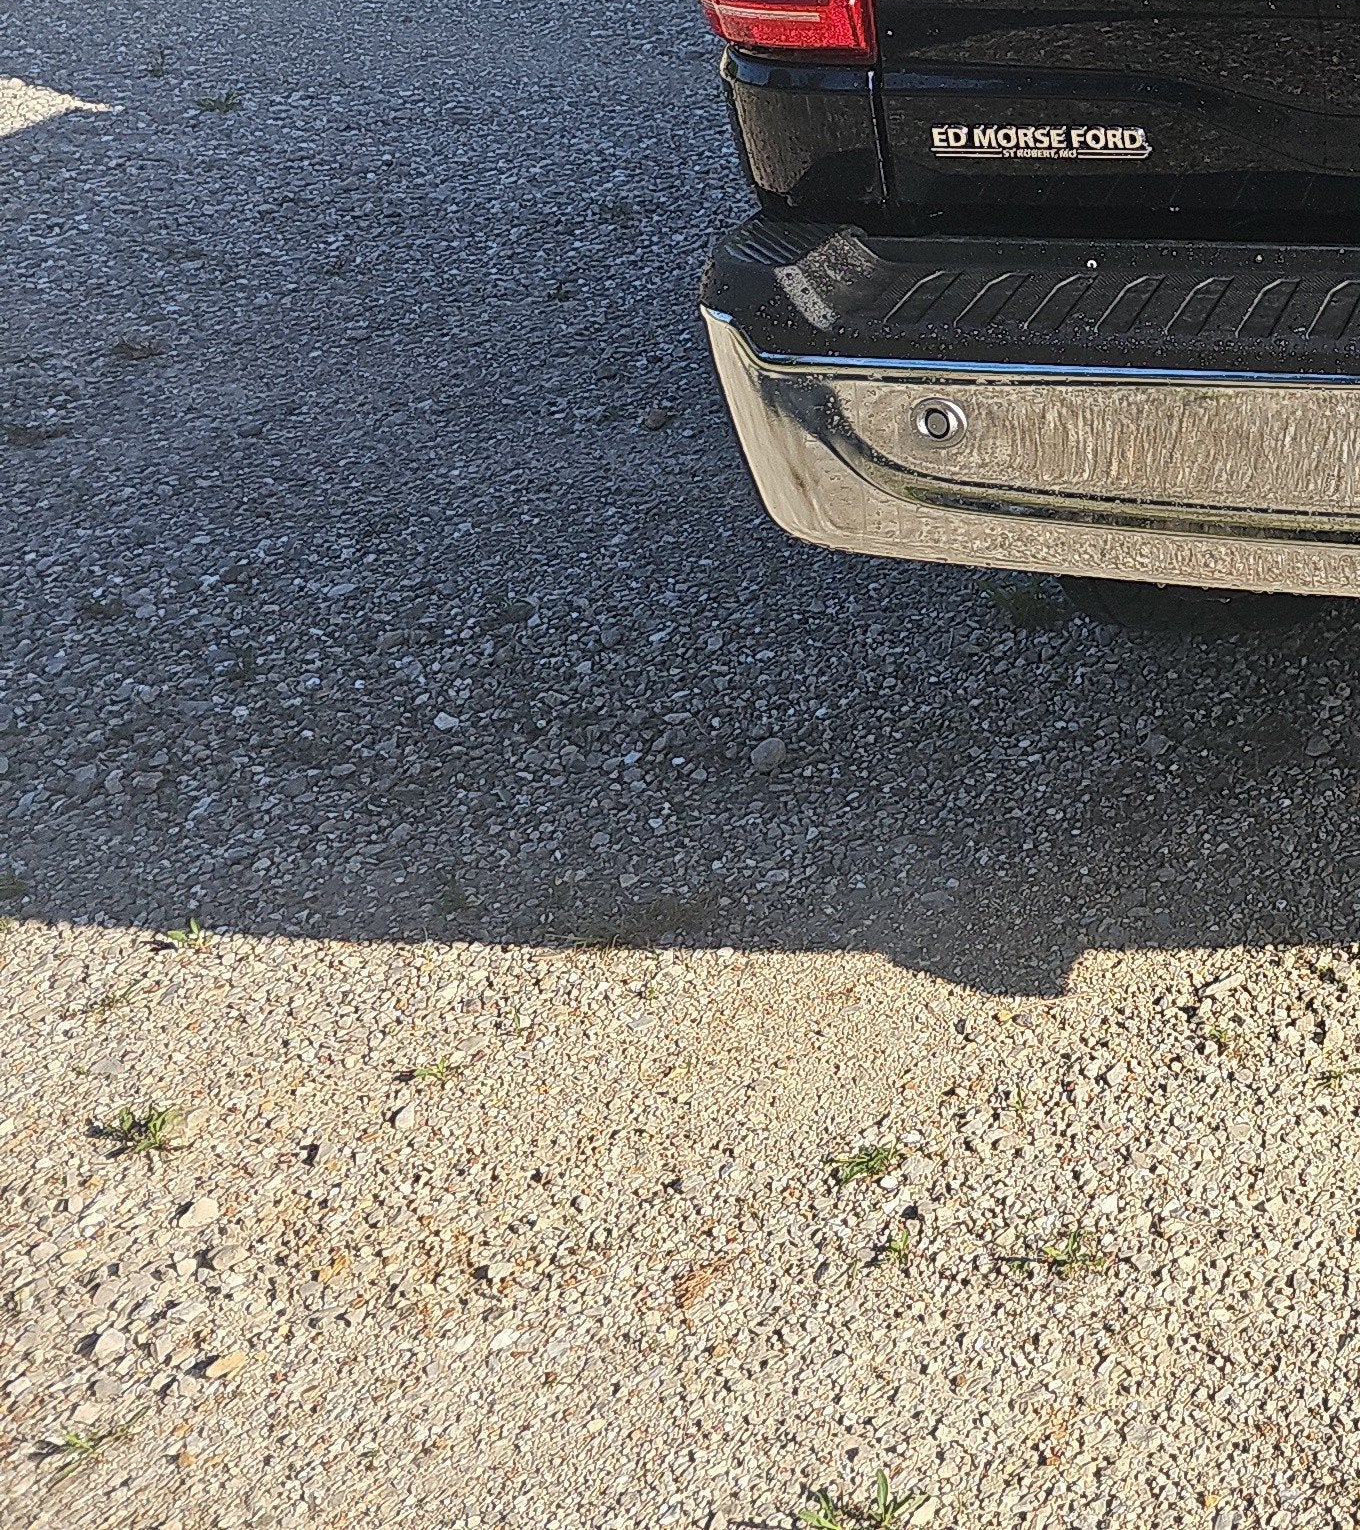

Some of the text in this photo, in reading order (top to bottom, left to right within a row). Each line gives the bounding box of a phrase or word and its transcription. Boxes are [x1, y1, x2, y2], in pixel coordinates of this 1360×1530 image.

[931, 124, 1147, 150] ED MORSE FORD
